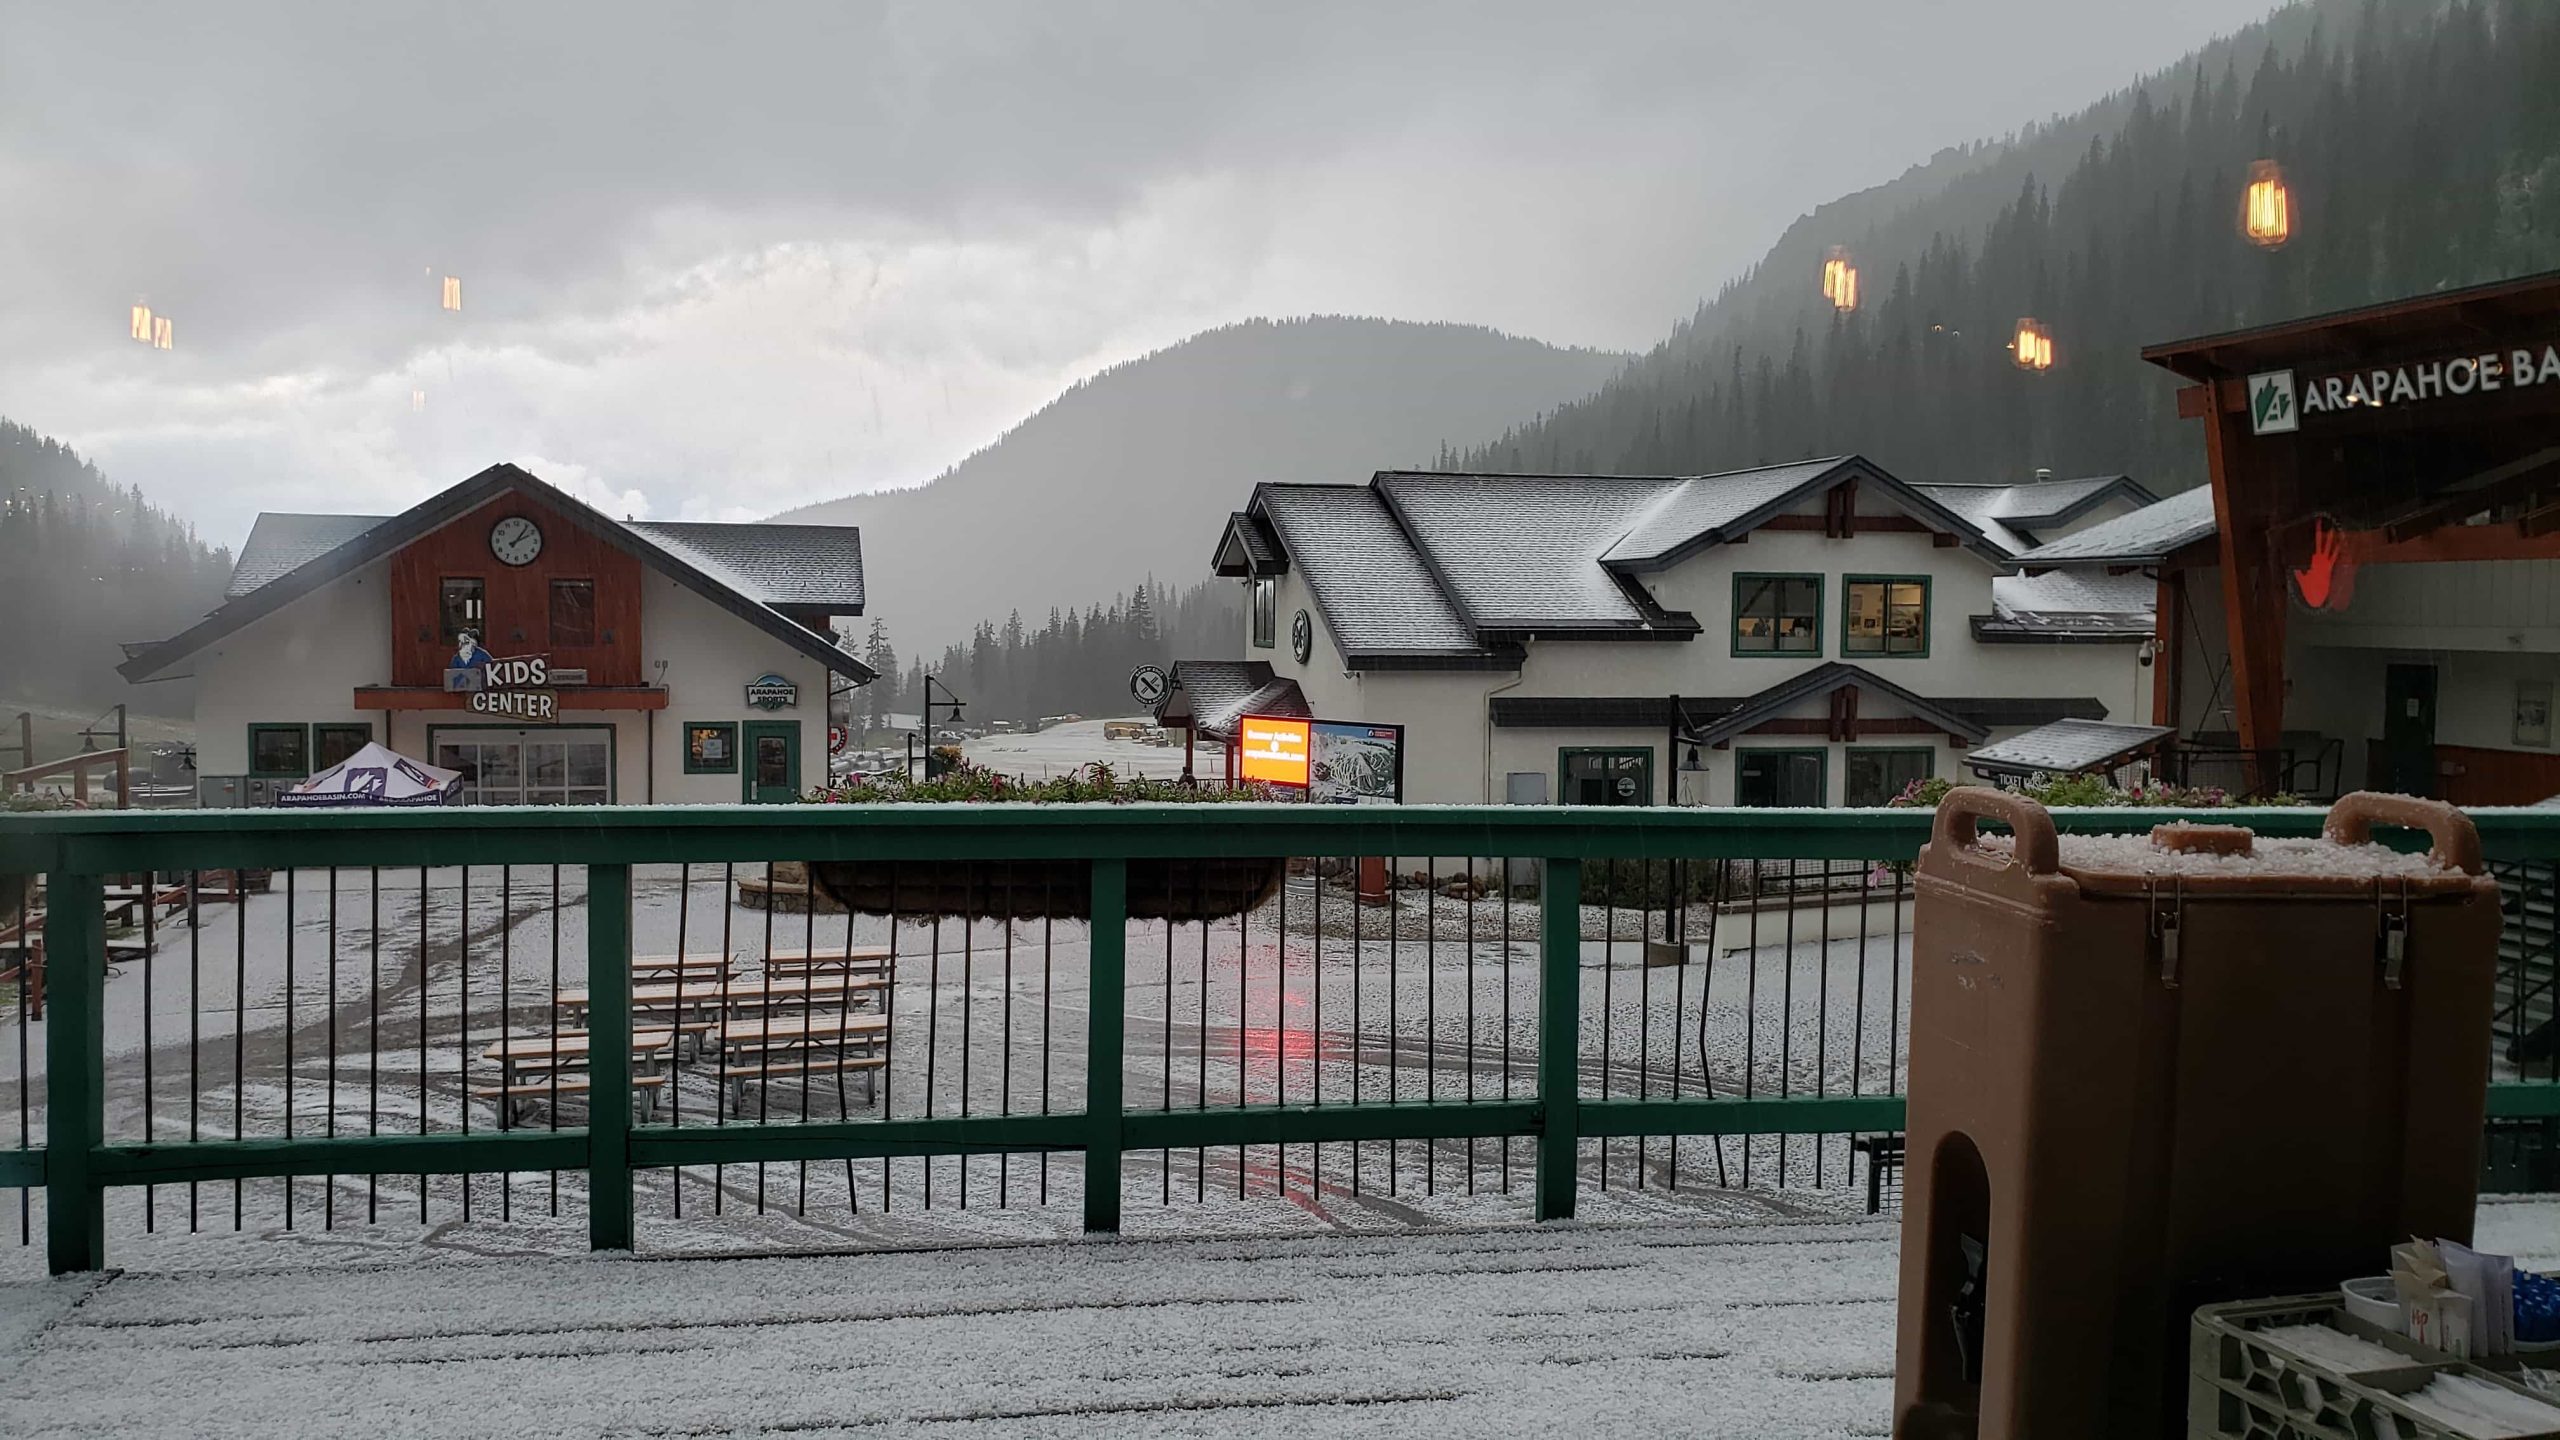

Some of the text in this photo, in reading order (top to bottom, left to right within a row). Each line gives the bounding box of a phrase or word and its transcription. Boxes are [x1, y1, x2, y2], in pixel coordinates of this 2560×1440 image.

[2303, 345, 2560, 414] ARAPAHOE BA
[485, 658, 547, 687] KIDS
[472, 691, 552, 718] CENTER
[750, 688, 794, 696] ARAPAHOE
[1999, 774, 2022, 787] TICKET
